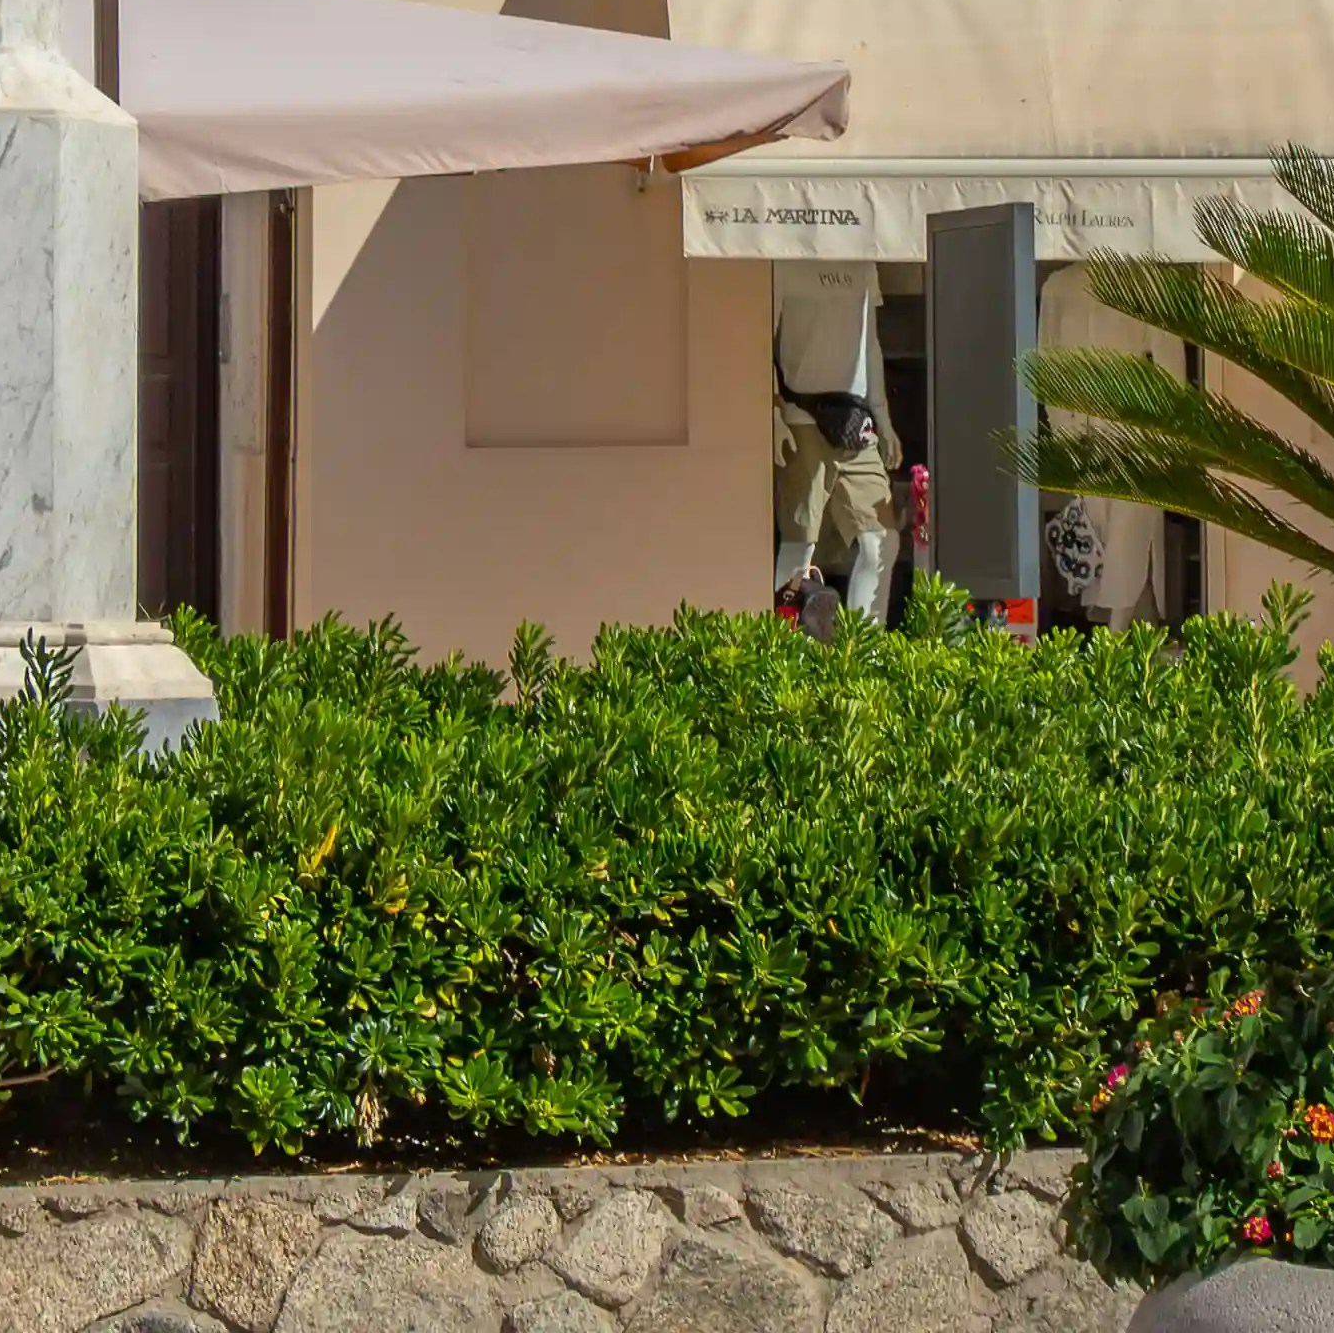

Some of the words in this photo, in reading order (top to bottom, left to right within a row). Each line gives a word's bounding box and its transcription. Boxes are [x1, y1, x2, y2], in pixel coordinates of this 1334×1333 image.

[732, 208, 759, 224] LA
[766, 208, 861, 226] MARTINA
[1081, 209, 1135, 228] LAUREN
